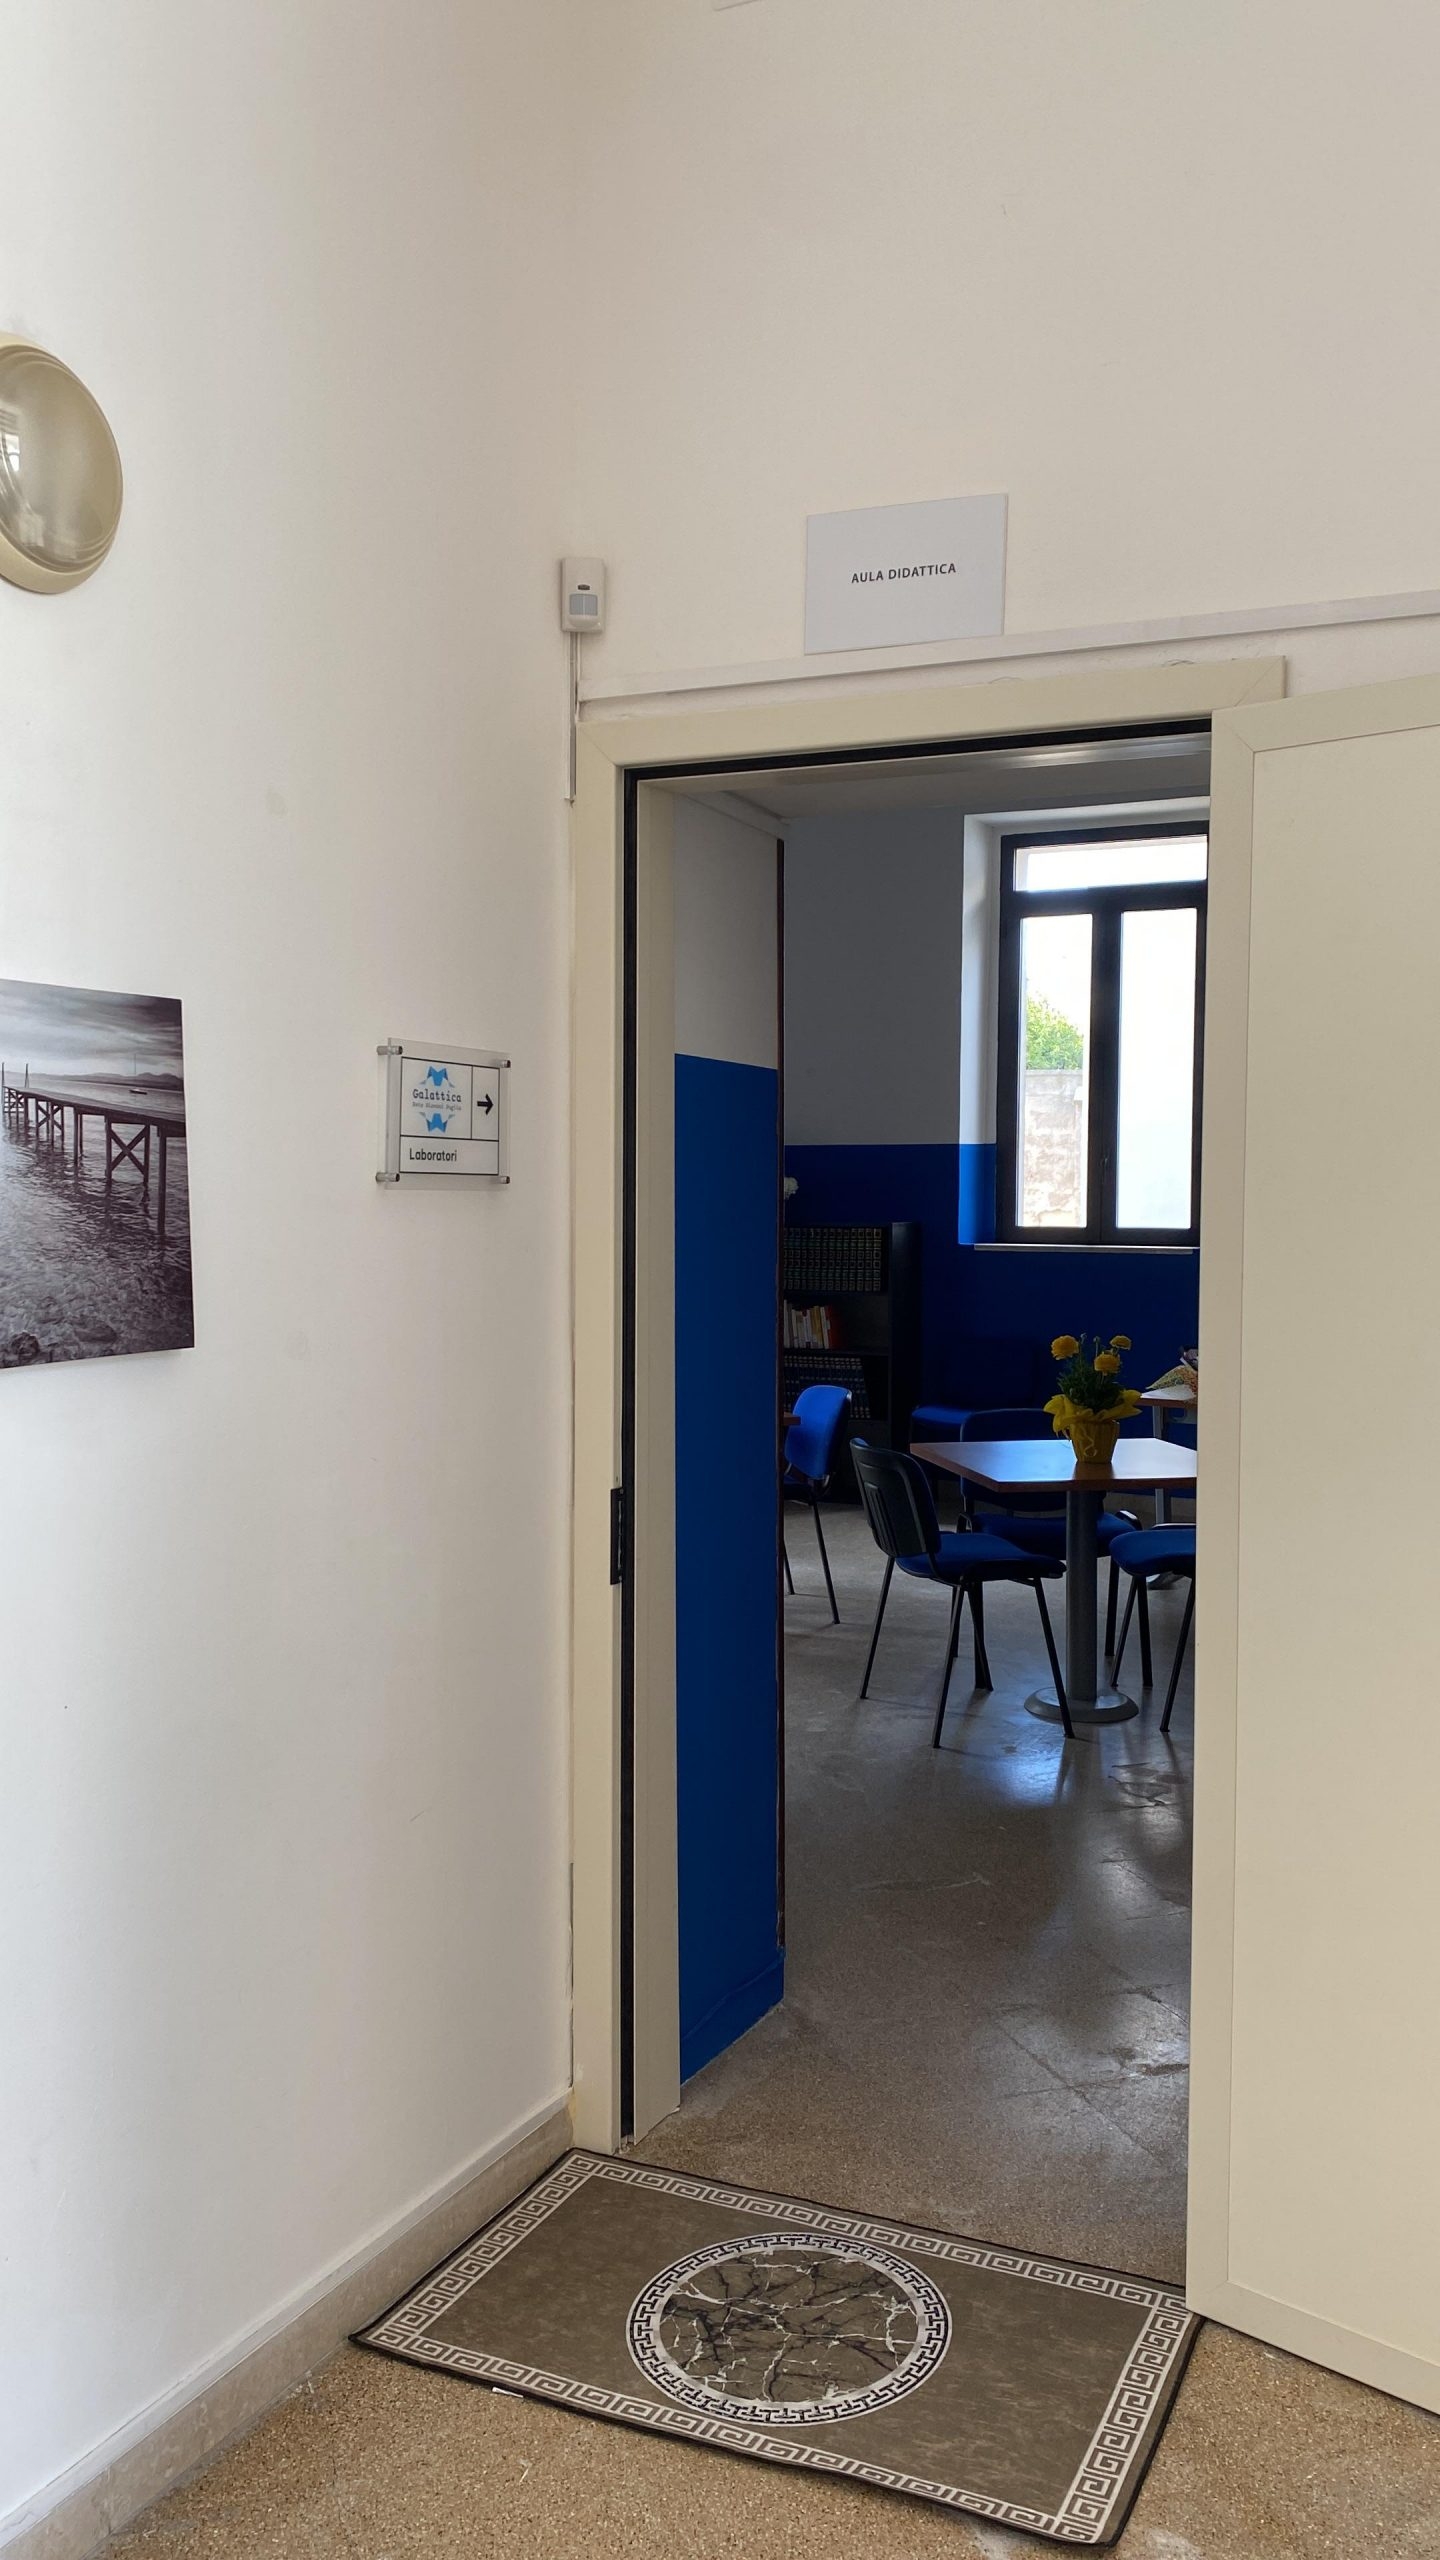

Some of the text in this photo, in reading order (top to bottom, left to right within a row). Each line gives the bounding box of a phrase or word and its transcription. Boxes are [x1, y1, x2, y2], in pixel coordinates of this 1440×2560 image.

[851, 563, 956, 583] AULA DIDATTICA
[412, 1088, 462, 1102] Galattica
[409, 1148, 457, 1162] Laboratori
